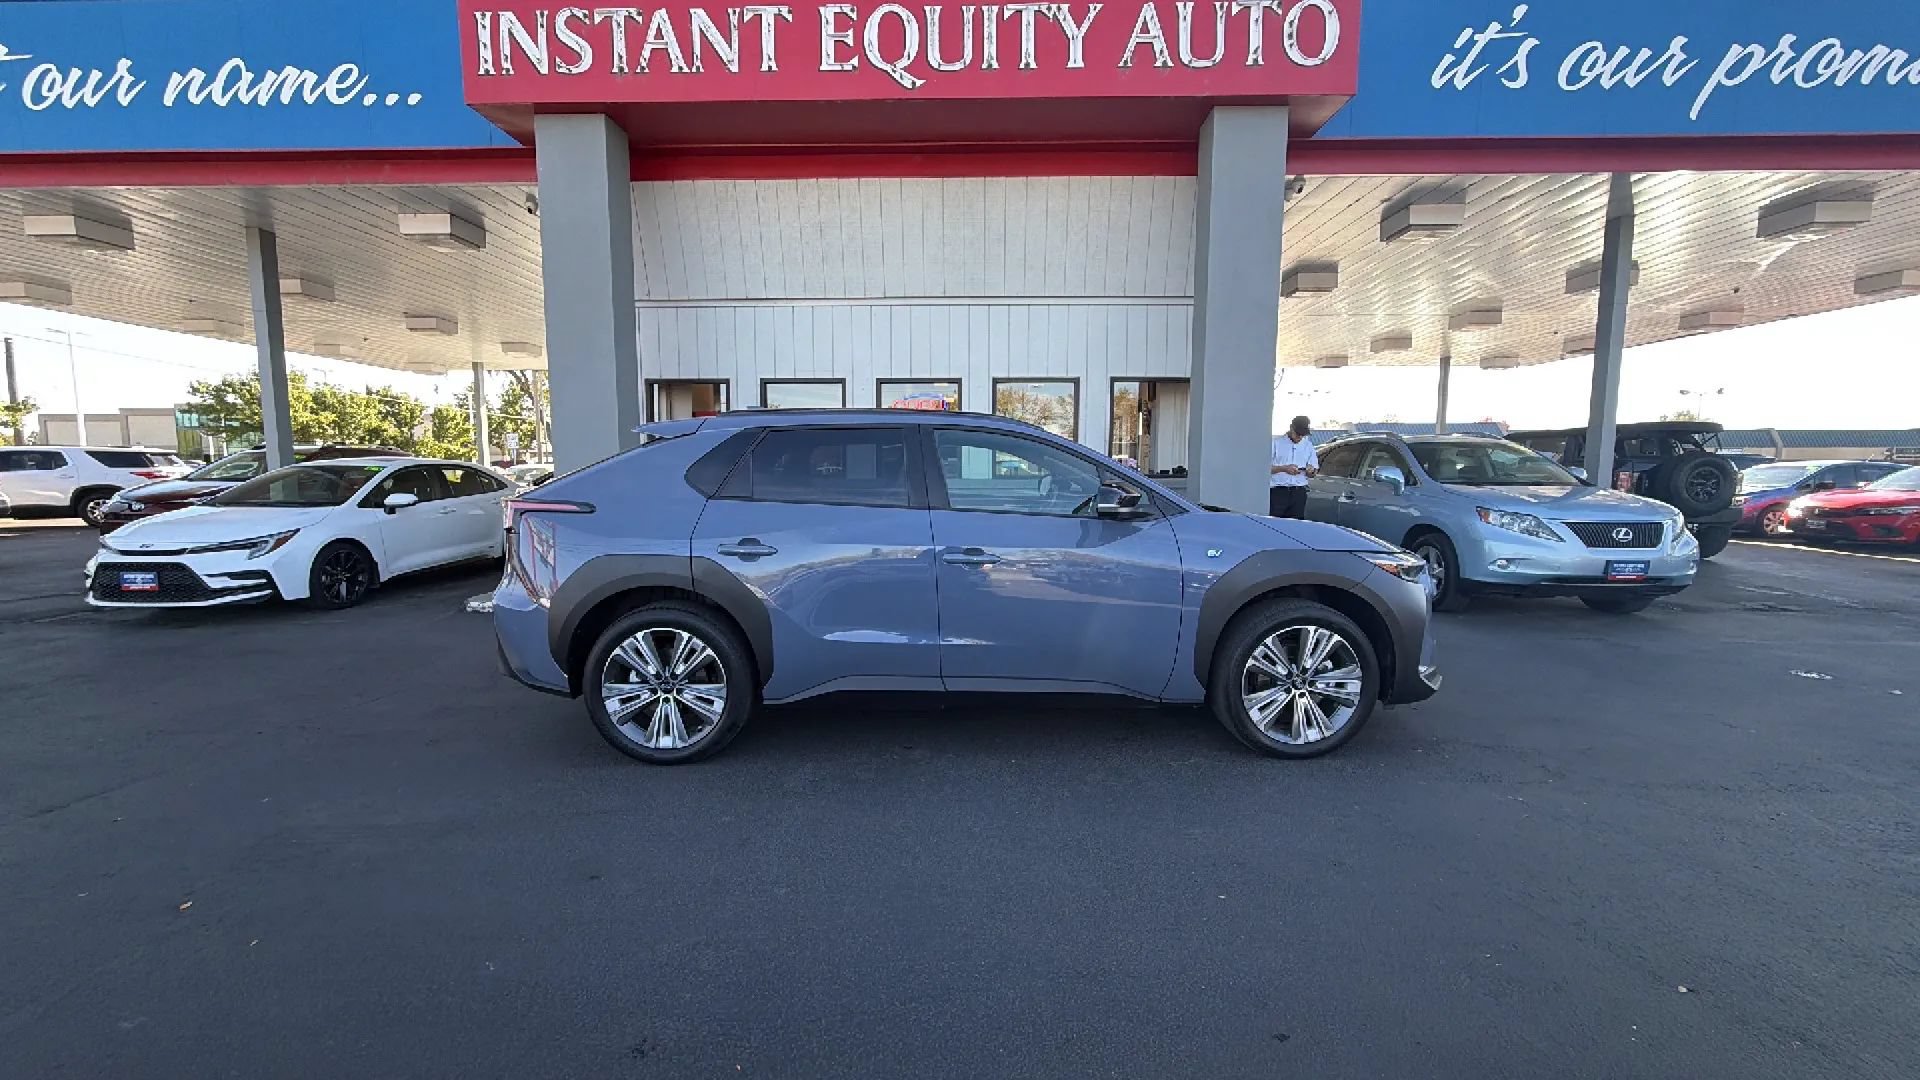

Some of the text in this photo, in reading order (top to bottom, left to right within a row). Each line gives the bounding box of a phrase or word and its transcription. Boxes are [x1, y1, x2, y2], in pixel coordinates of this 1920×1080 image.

[22, 58, 146, 111] our
[163, 58, 422, 106] name...
[474, 0, 1341, 89] INSTANT EQUITY AUTO
[1430, 4, 1540, 91] it's
[1558, 35, 1700, 91] our
